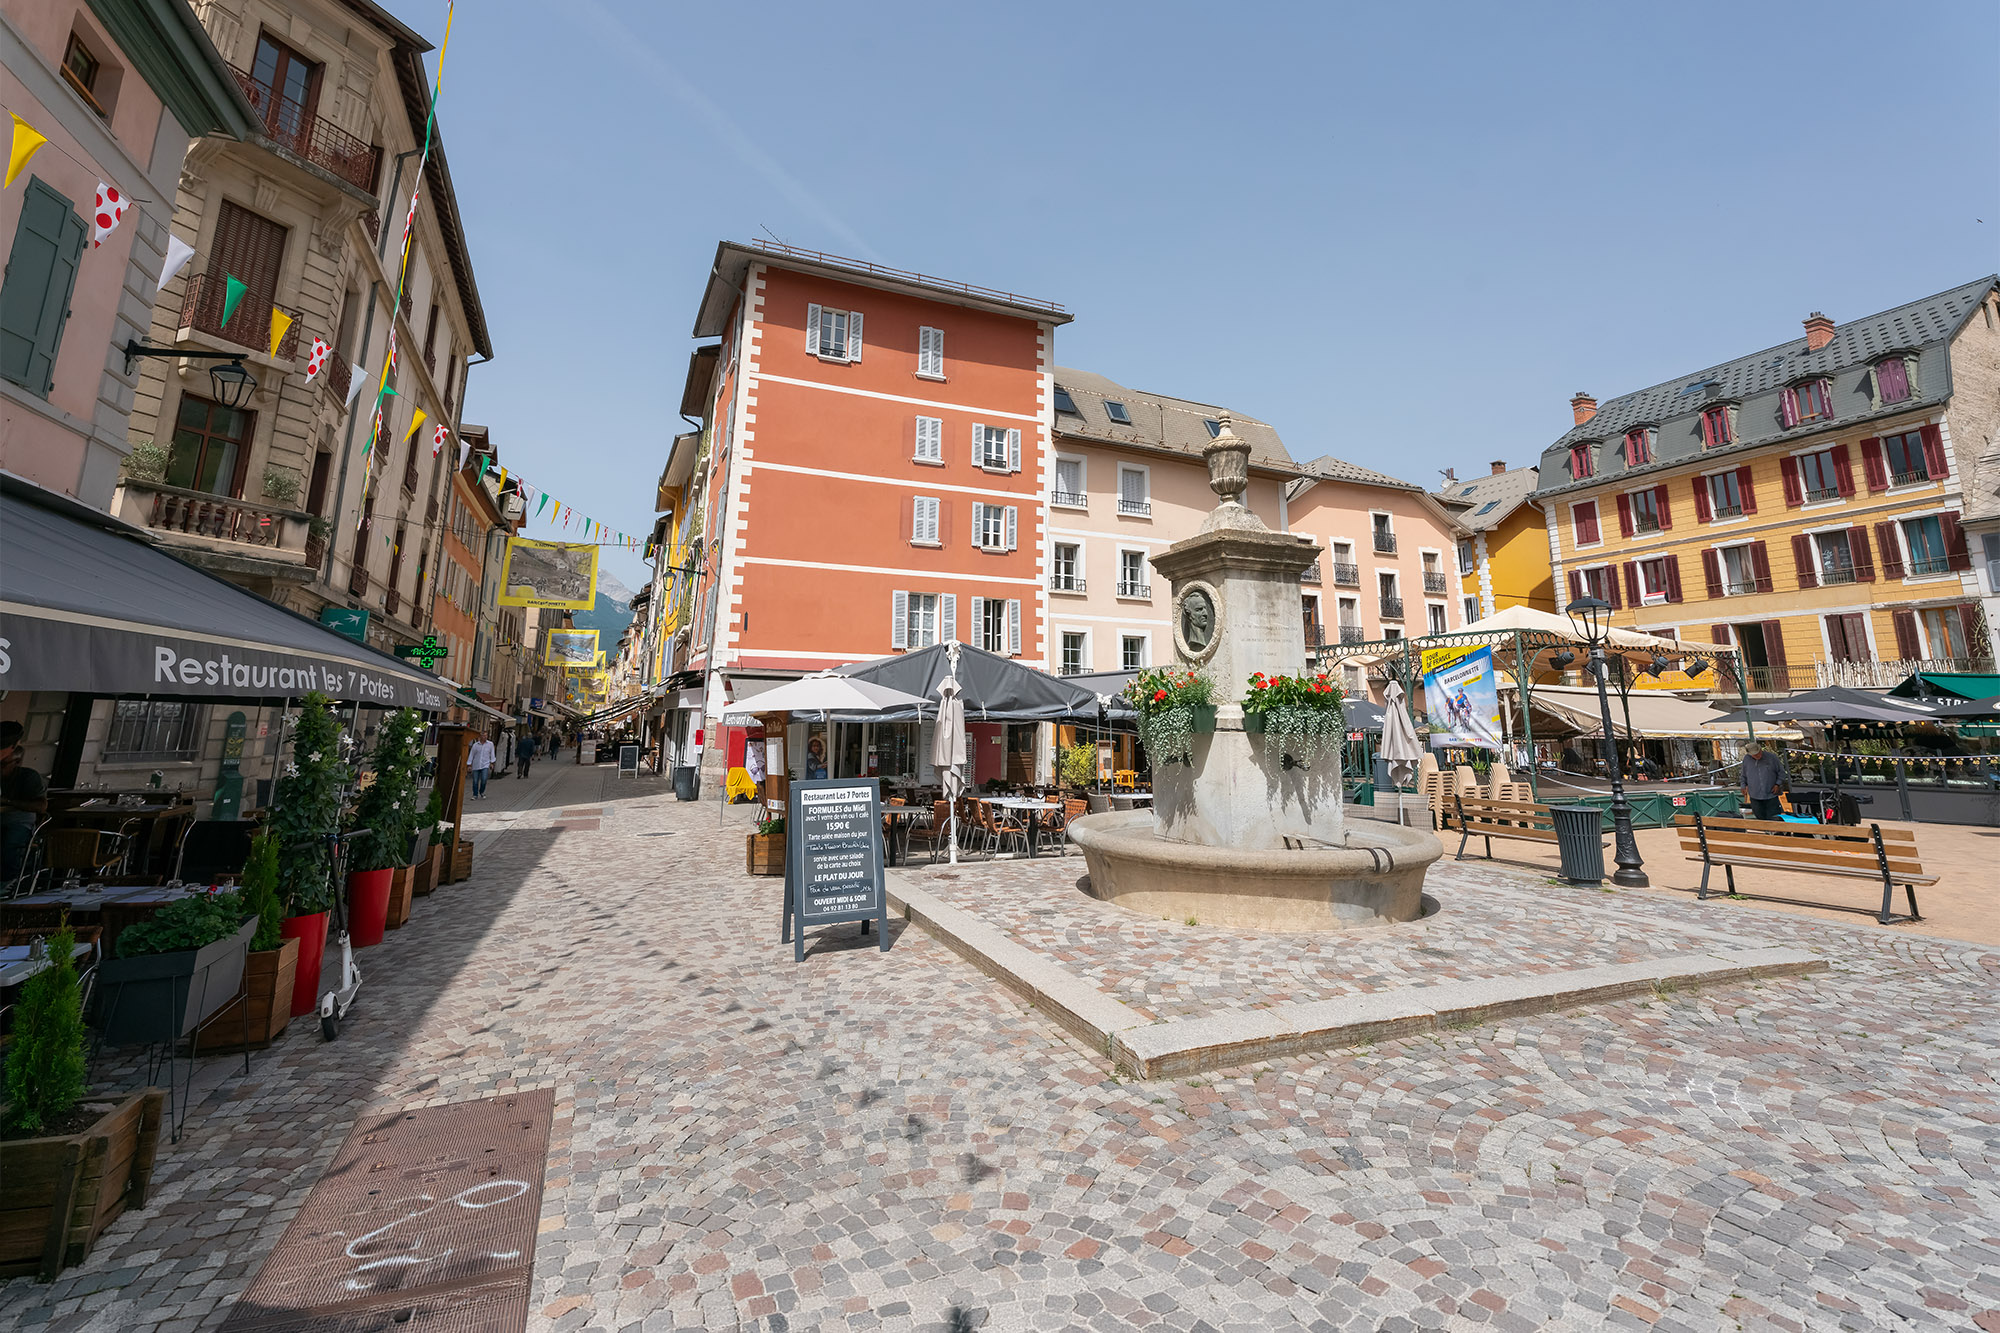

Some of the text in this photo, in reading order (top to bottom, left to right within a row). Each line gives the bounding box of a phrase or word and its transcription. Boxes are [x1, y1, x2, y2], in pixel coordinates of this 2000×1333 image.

[155, 646, 394, 700] Restaurant les 7 Portes
[804, 792, 836, 802] Restaurant
[836, 792, 846, 800] Les
[852, 790, 870, 798] Portes
[808, 806, 842, 814] FORMULES
[852, 804, 866, 812] Midi
[845, 821, 850, 830] €
[814, 874, 822, 882] LE
[823, 873, 837, 881] PLAT
[848, 871, 864, 879] JOUR
[814, 897, 836, 906] OUVERT
[837, 896, 849, 904] MIDI
